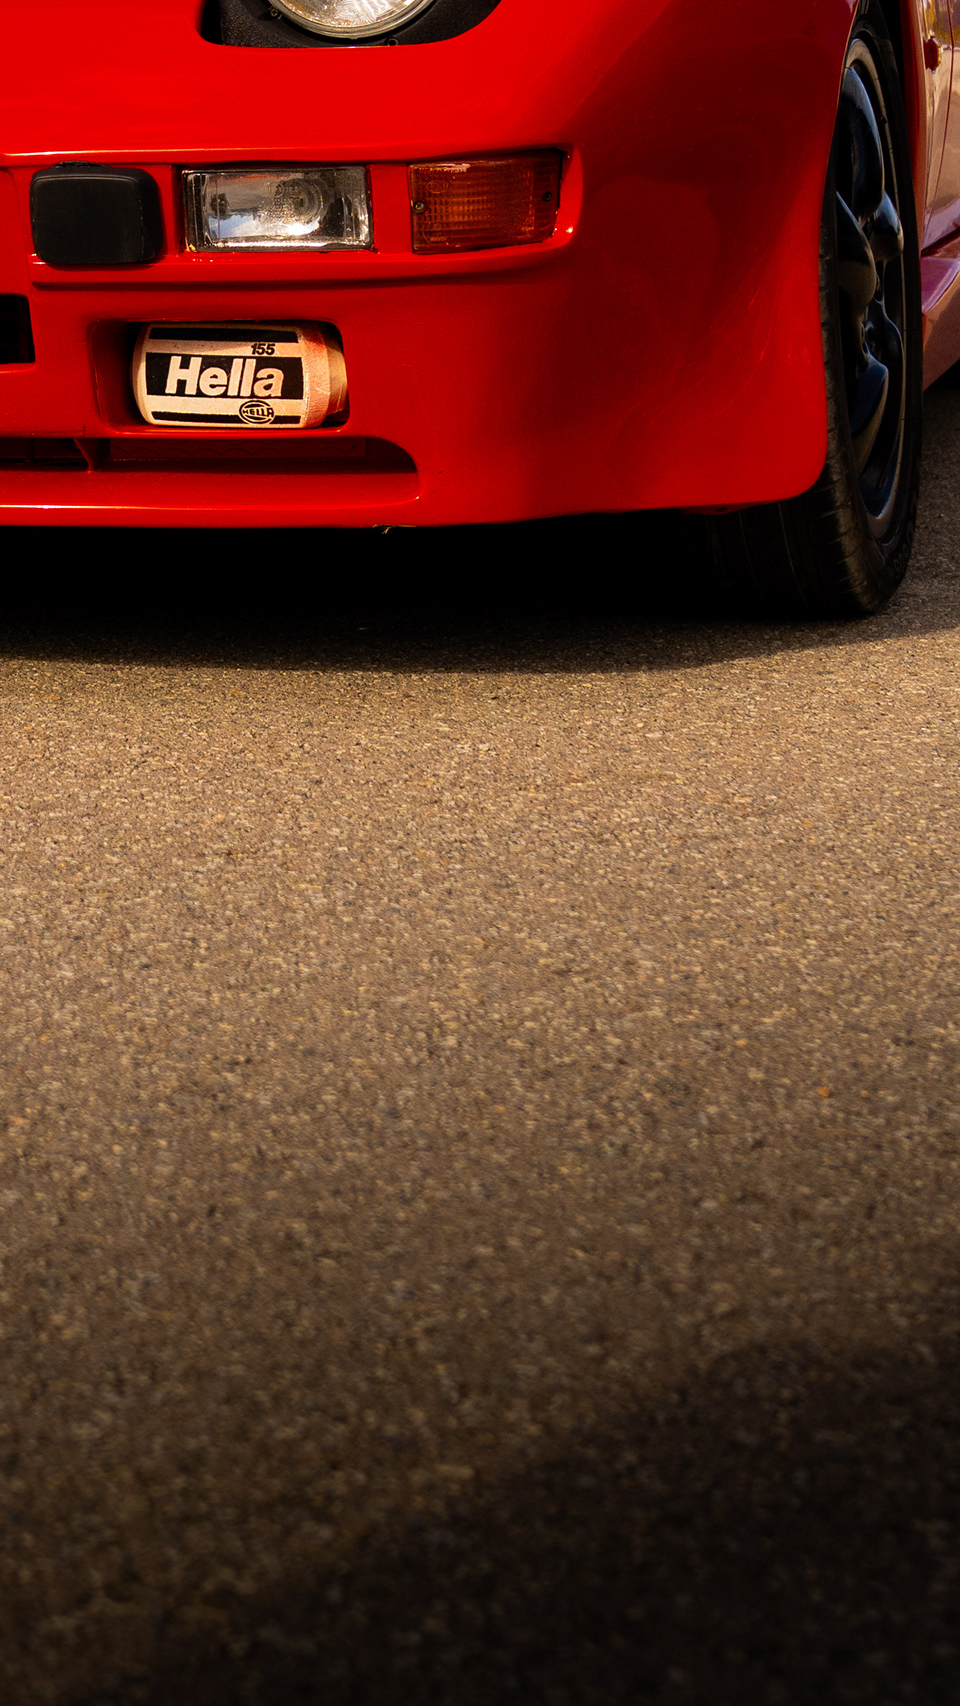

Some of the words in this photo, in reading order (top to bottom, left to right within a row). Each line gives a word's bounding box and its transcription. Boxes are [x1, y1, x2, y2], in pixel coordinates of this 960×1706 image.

[251, 343, 276, 356] 155
[165, 355, 285, 397] Hella
[243, 407, 274, 419] HELLA
